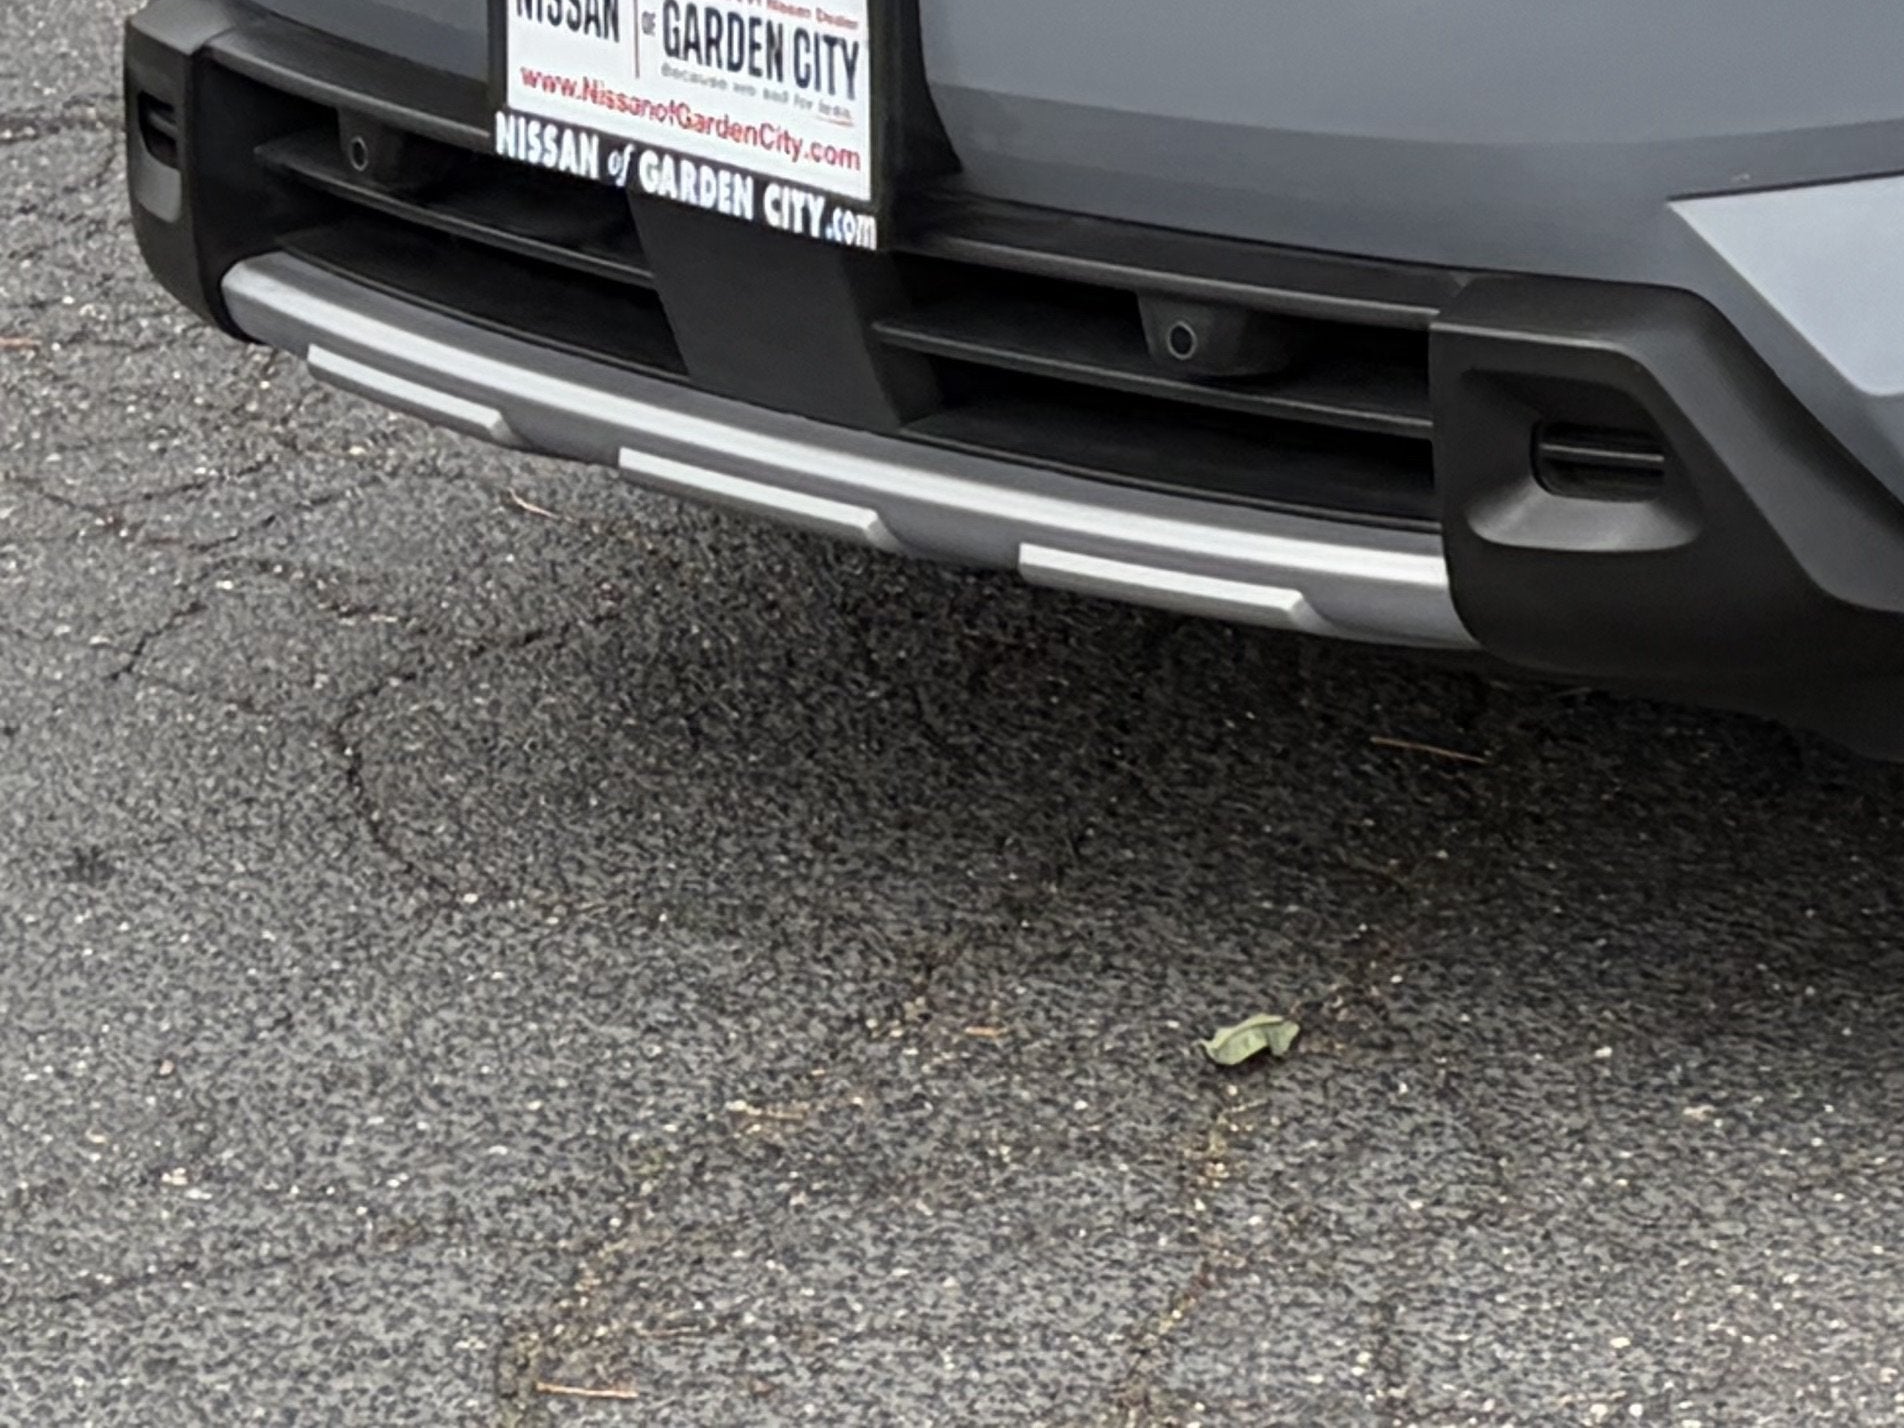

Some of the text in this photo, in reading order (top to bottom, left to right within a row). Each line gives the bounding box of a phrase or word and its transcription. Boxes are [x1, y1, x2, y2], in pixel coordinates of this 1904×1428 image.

[793, 27, 860, 101] CITY
[495, 111, 599, 180] NISSAN
[607, 144, 635, 188] of
[639, 150, 754, 220] GARDEN
[520, 65, 861, 172] www.NissanofGardenCity.com
